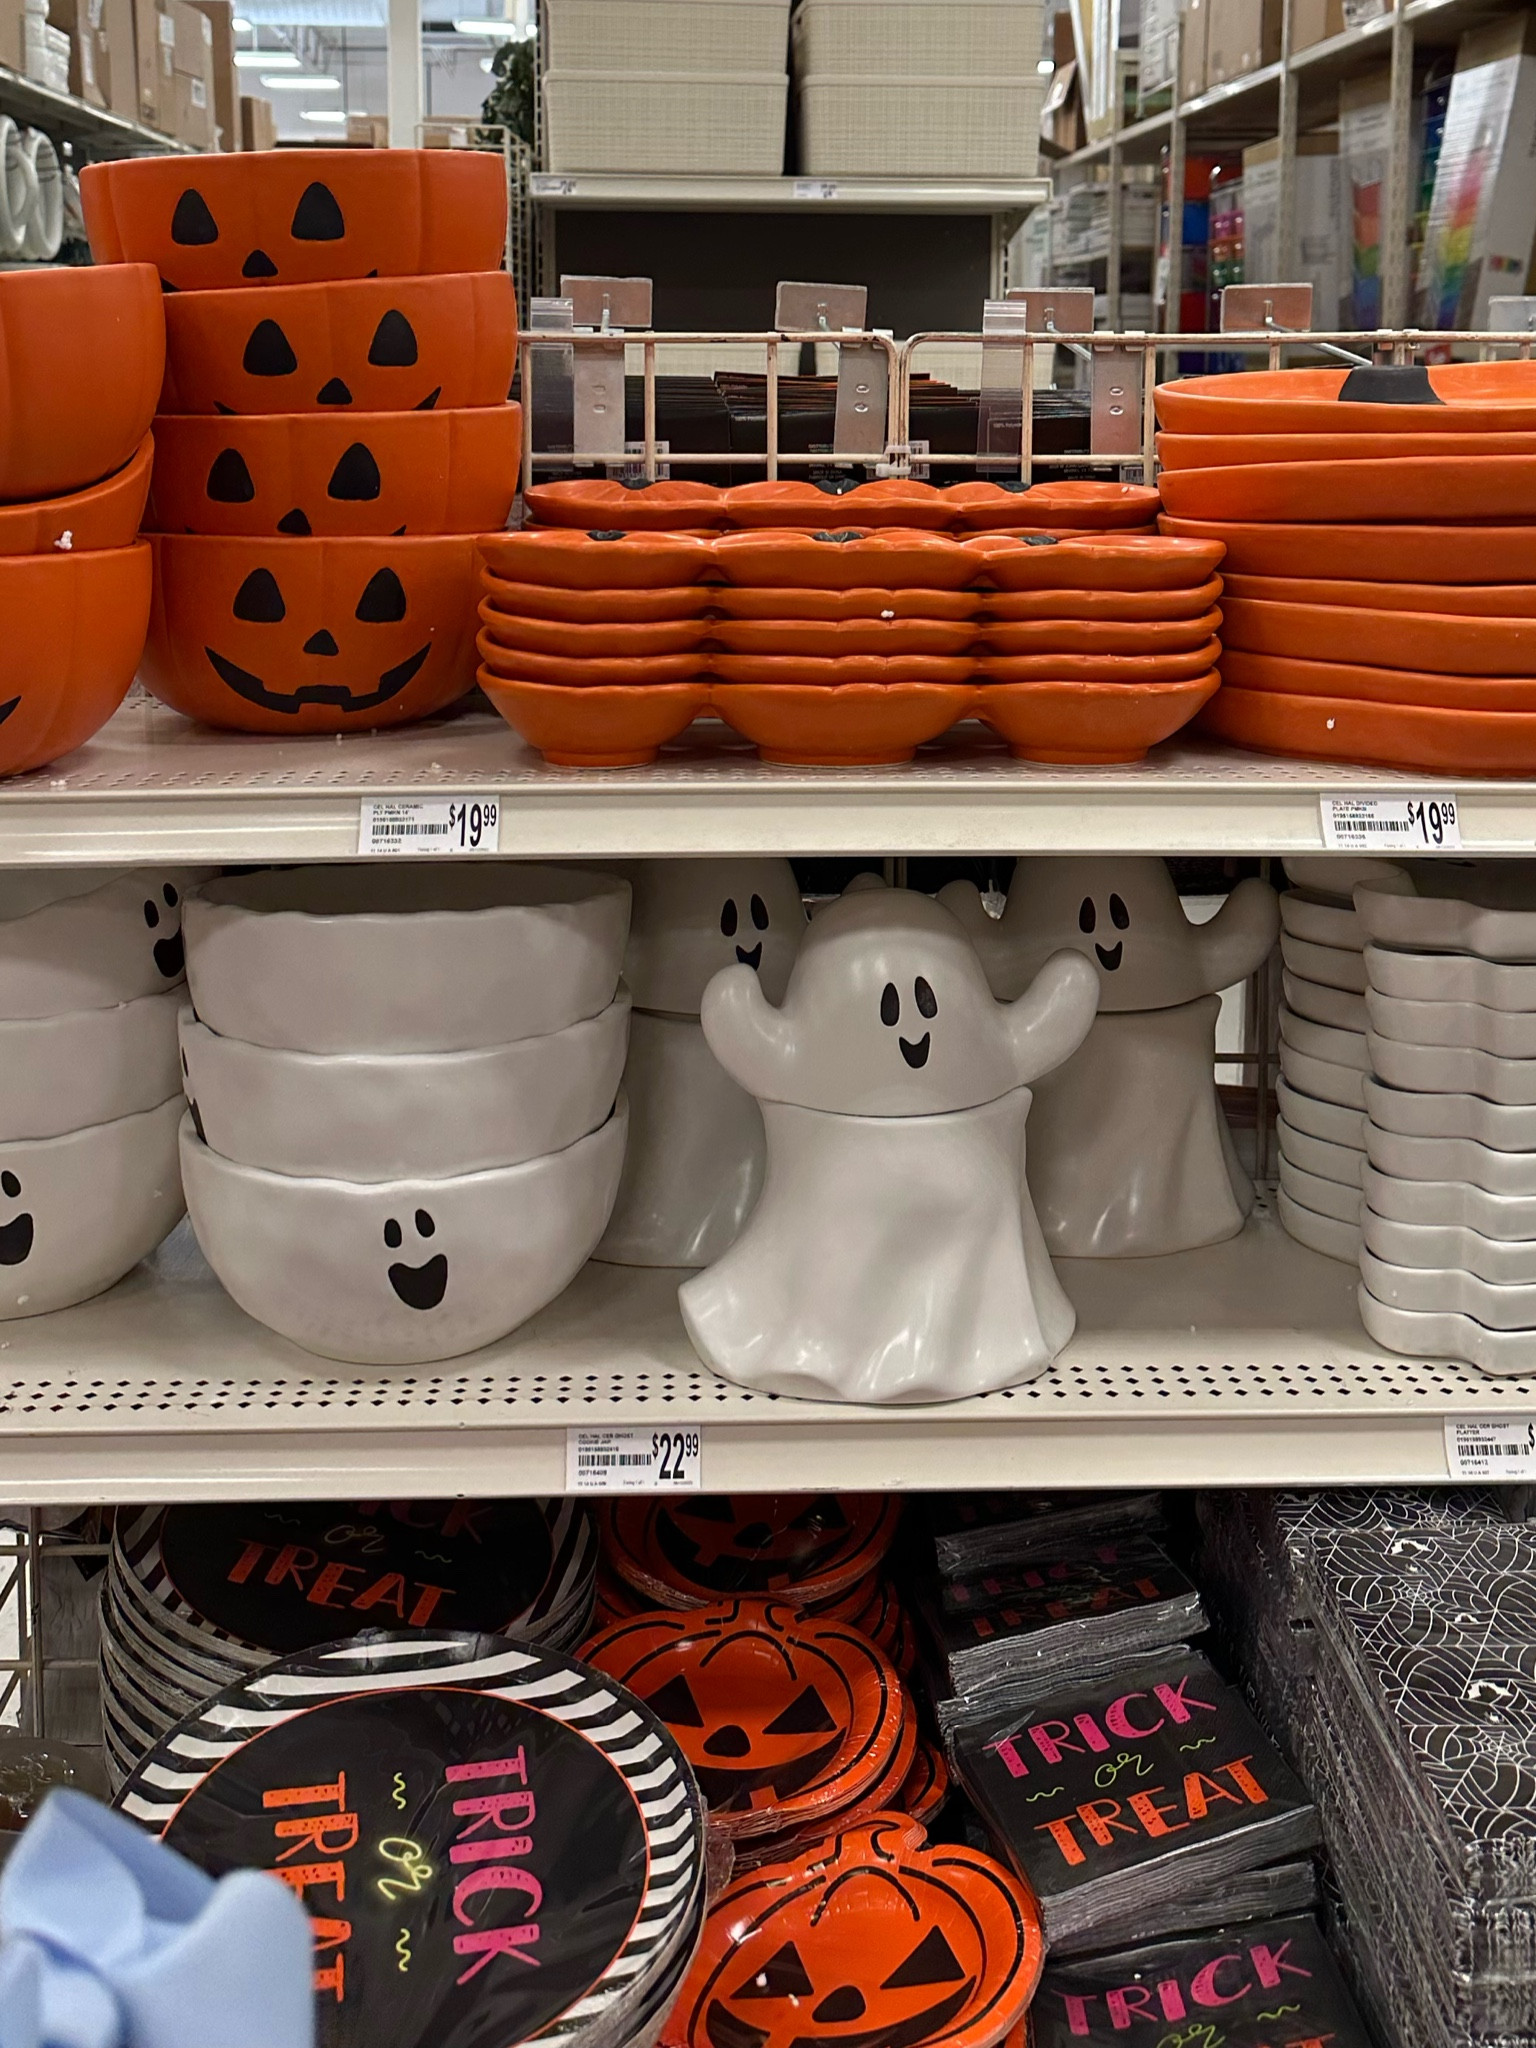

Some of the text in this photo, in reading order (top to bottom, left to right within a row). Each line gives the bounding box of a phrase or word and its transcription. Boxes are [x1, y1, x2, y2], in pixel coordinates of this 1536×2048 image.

[227, 1539, 457, 1627] TREAT
[324, 1525, 386, 1553] or
[982, 1675, 1217, 1778] TRICK
[1094, 1752, 1155, 1788] or
[1033, 1755, 1269, 1867] TREAT
[377, 1836, 434, 1902] or
[444, 1744, 543, 1986] TRICK
[1050, 1938, 1313, 2037] TRICK
